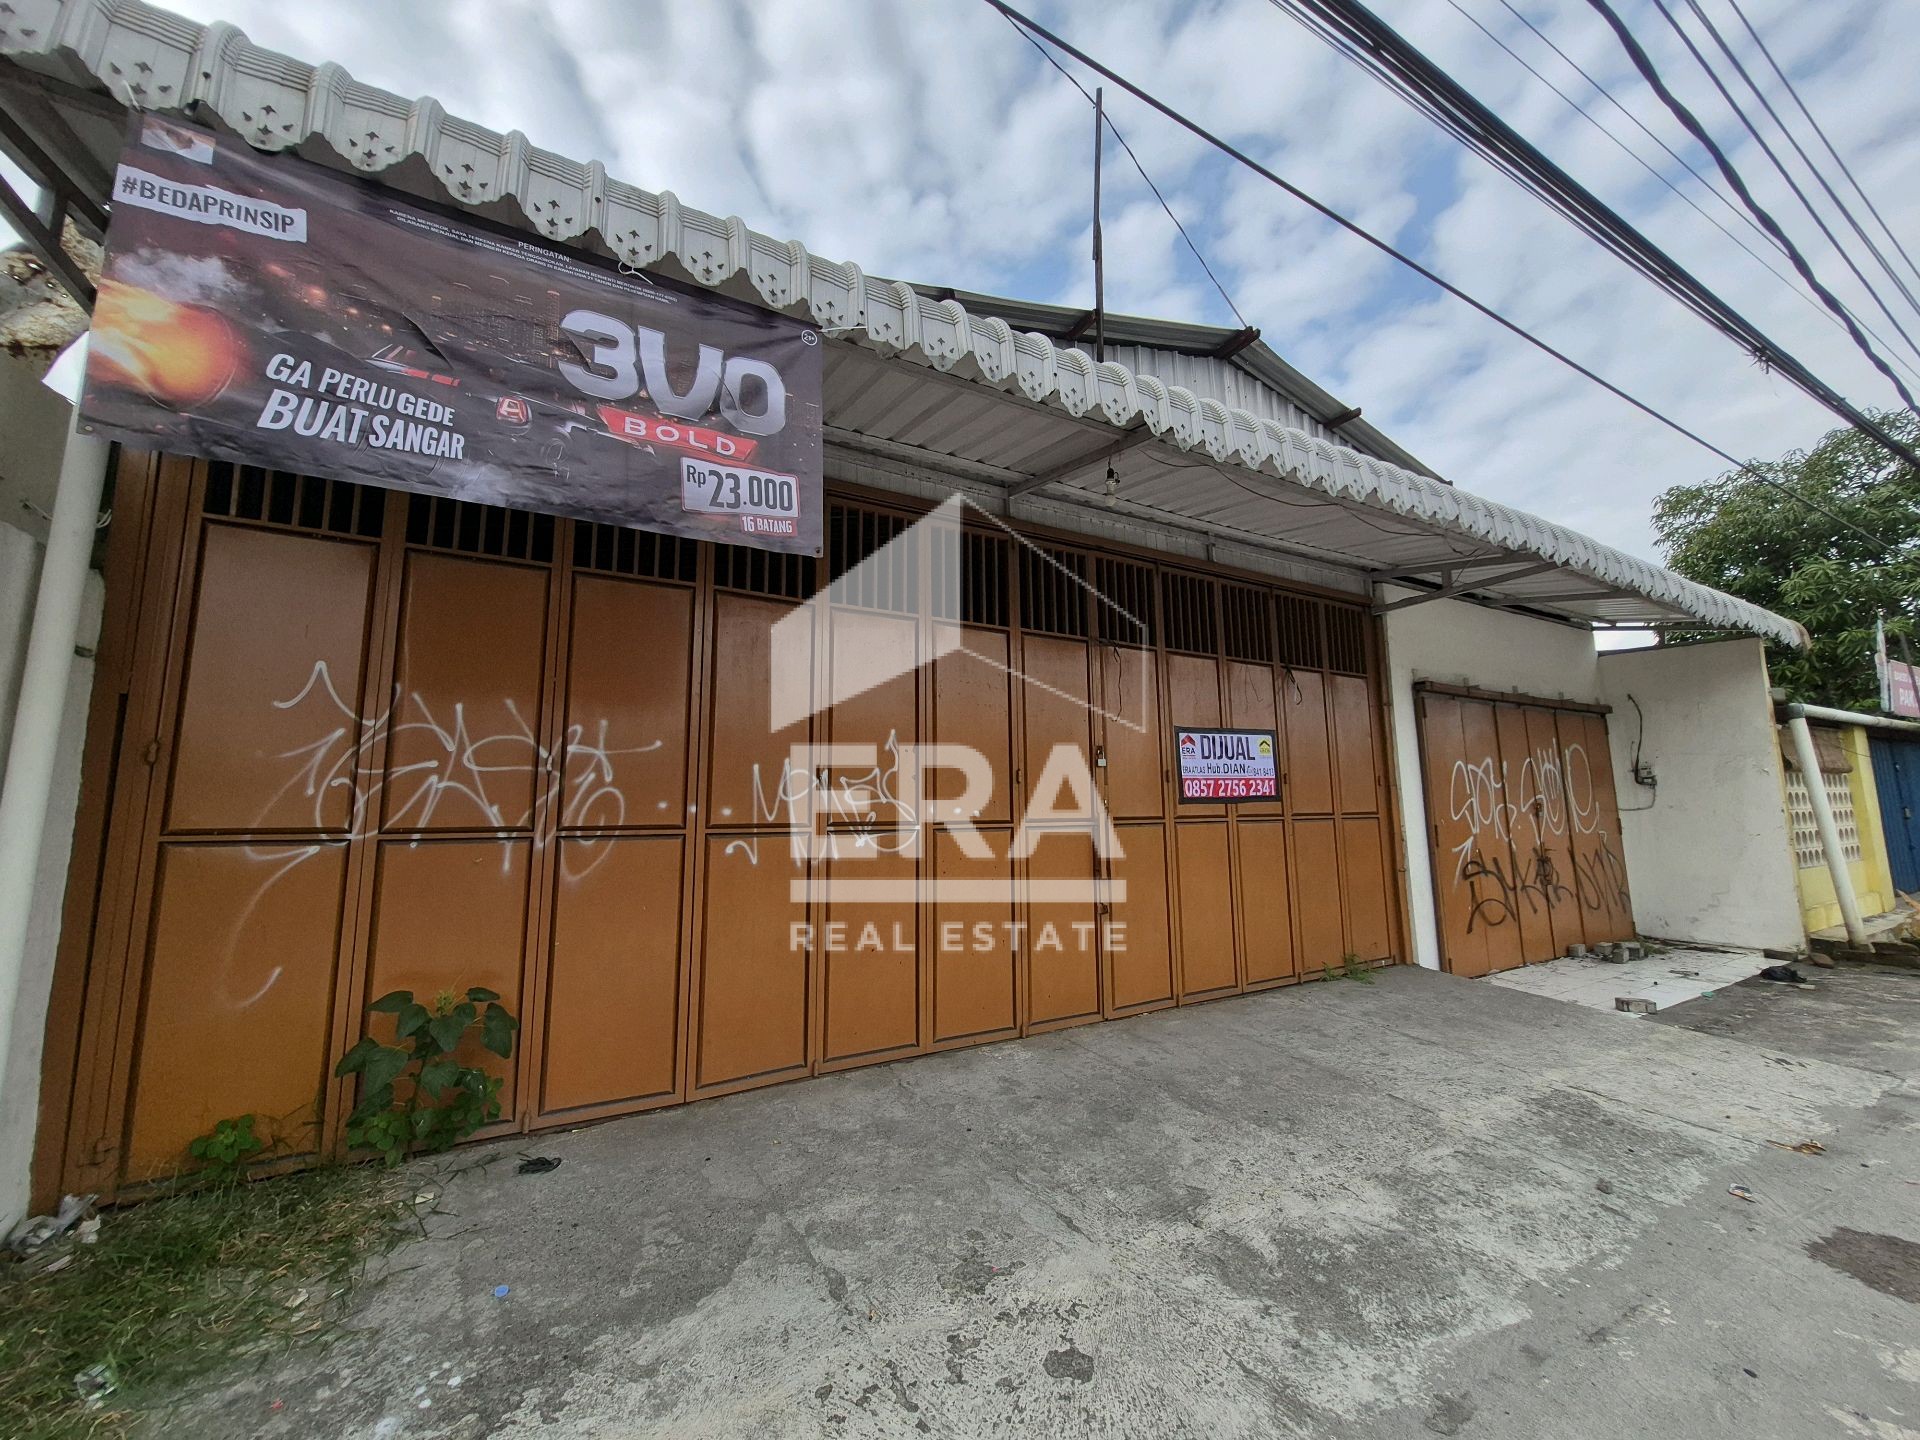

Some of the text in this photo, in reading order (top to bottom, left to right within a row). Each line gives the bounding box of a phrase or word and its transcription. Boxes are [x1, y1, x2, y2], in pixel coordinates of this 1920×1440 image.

[121, 175, 295, 234] #BEDAPRINSIP
[389, 209, 416, 221] KARENA
[396, 216, 430, 230] DILARANG
[431, 226, 460, 240] MENJUAL
[460, 236, 474, 244] DAN
[518, 241, 572, 263] PERINGATAN:
[265, 353, 456, 427] GA PERLU GEDE
[256, 388, 465, 460] BUAT SANGAR
[624, 416, 736, 456] BOLD
[708, 469, 793, 511] 23.000
[741, 515, 793, 533] 16 BATANG
[1181, 747, 1196, 755] ERA
[1200, 734, 1255, 760] DIJUAL
[1223, 763, 1246, 774] DIAN
[1184, 779, 1275, 797] 0857 2756 2341
